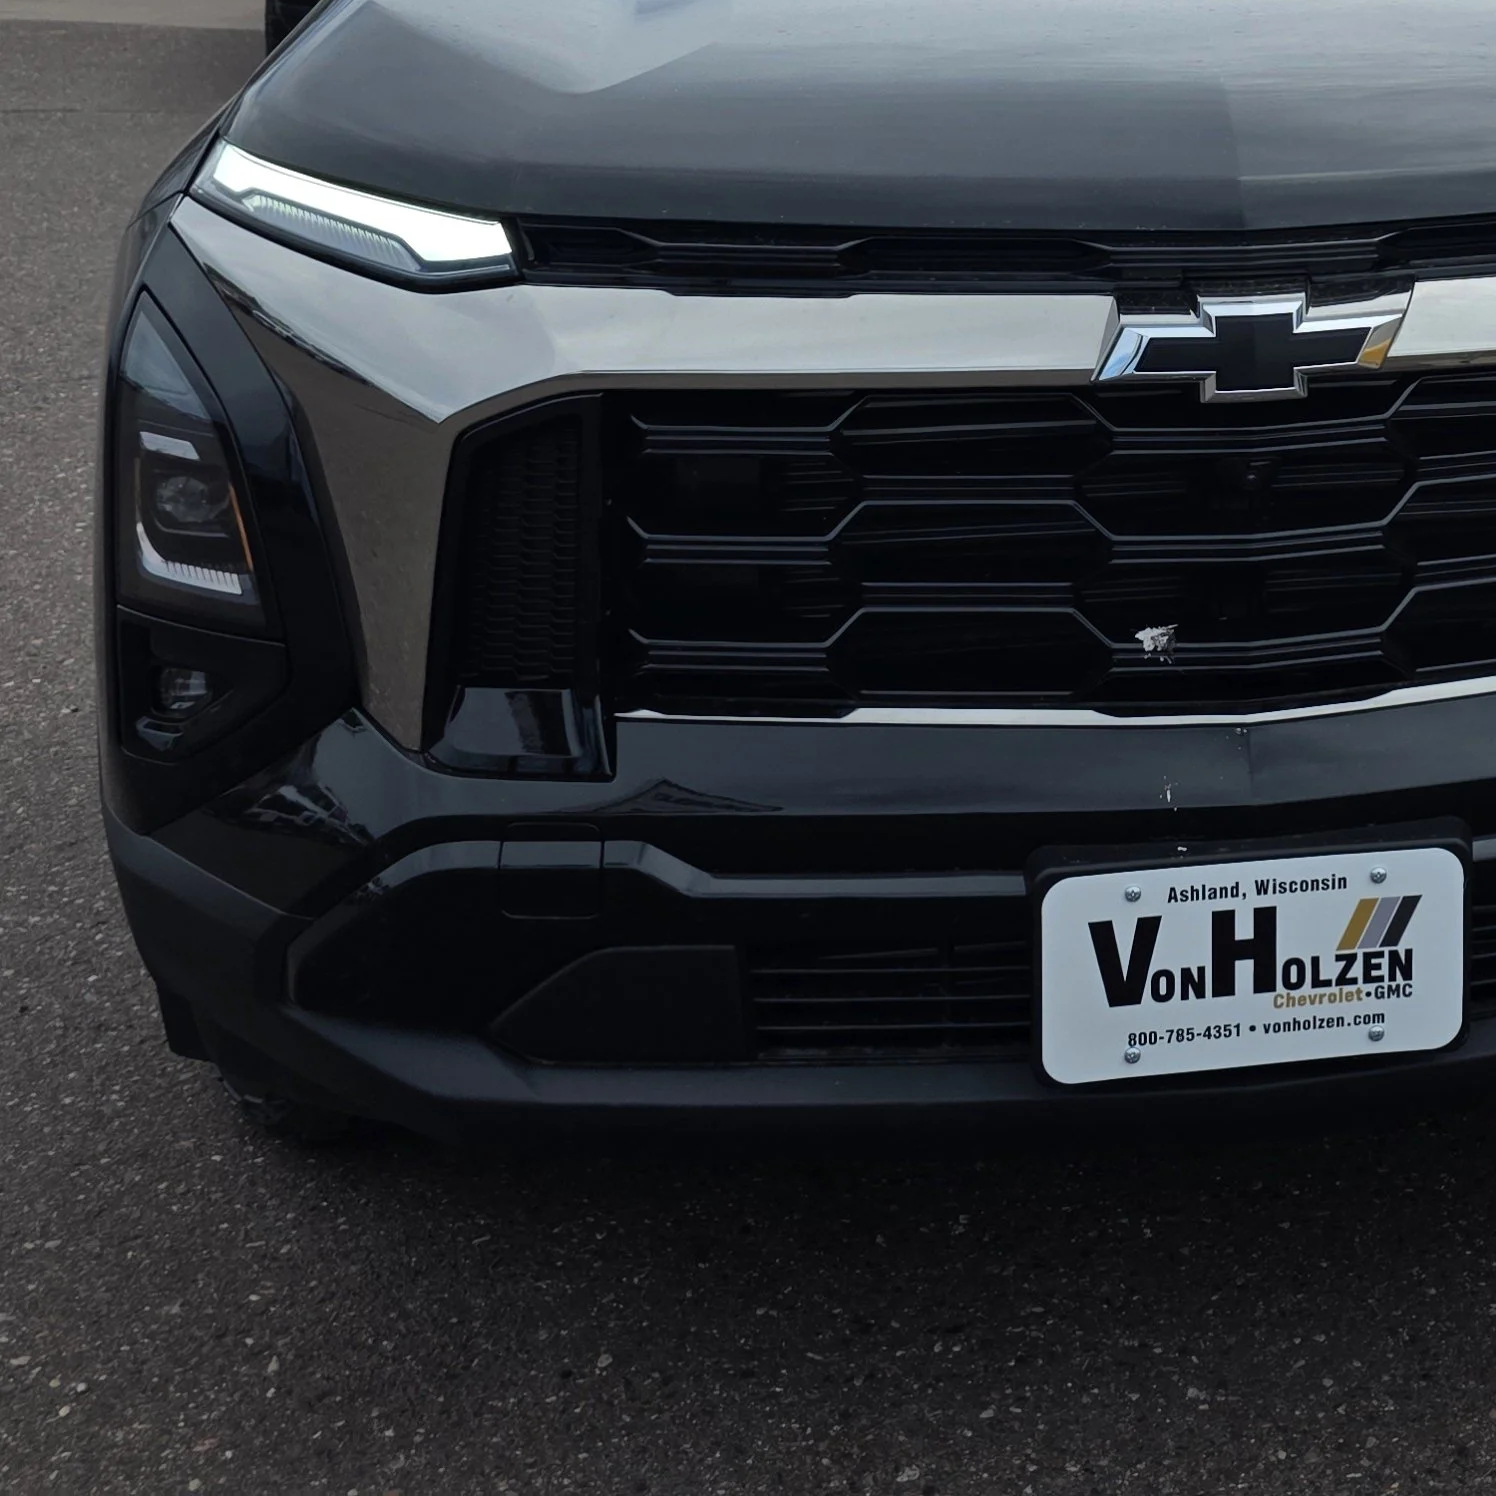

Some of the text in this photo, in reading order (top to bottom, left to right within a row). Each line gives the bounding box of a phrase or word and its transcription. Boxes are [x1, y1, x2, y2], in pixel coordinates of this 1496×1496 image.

[1167, 874, 1348, 903] Ashland, Wisconsin
[1128, 1012, 1385, 1047] 800-785-4351 vonholzen.com
